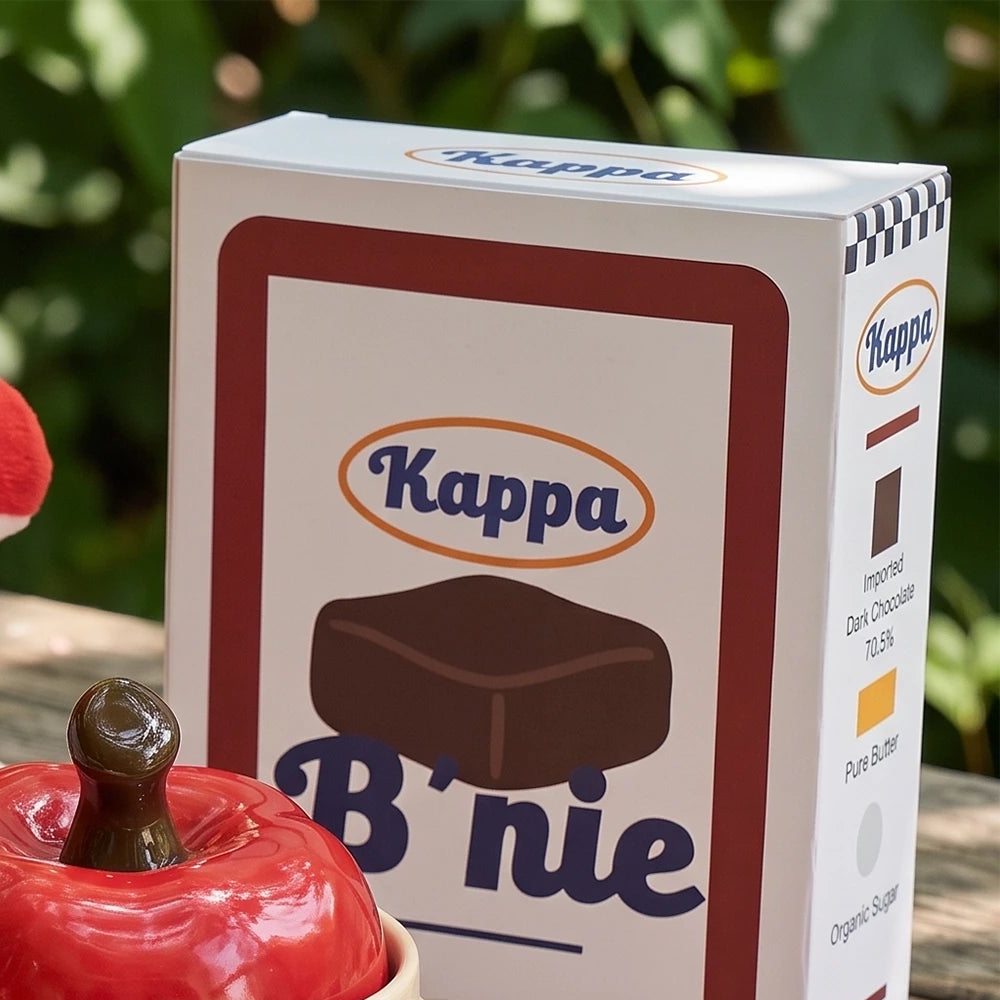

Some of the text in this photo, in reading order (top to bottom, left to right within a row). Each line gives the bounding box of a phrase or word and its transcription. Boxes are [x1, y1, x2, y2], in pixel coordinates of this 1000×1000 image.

[441, 149, 700, 183] Kappa
[865, 307, 934, 373] Kappa
[368, 445, 628, 545] Kappa
[863, 552, 904, 594] Imported
[846, 582, 915, 637] Dark Chocolate
[865, 626, 895, 661] 70.5%
[845, 733, 899, 785] Pure Butter
[830, 883, 899, 946] Organic Sugar
